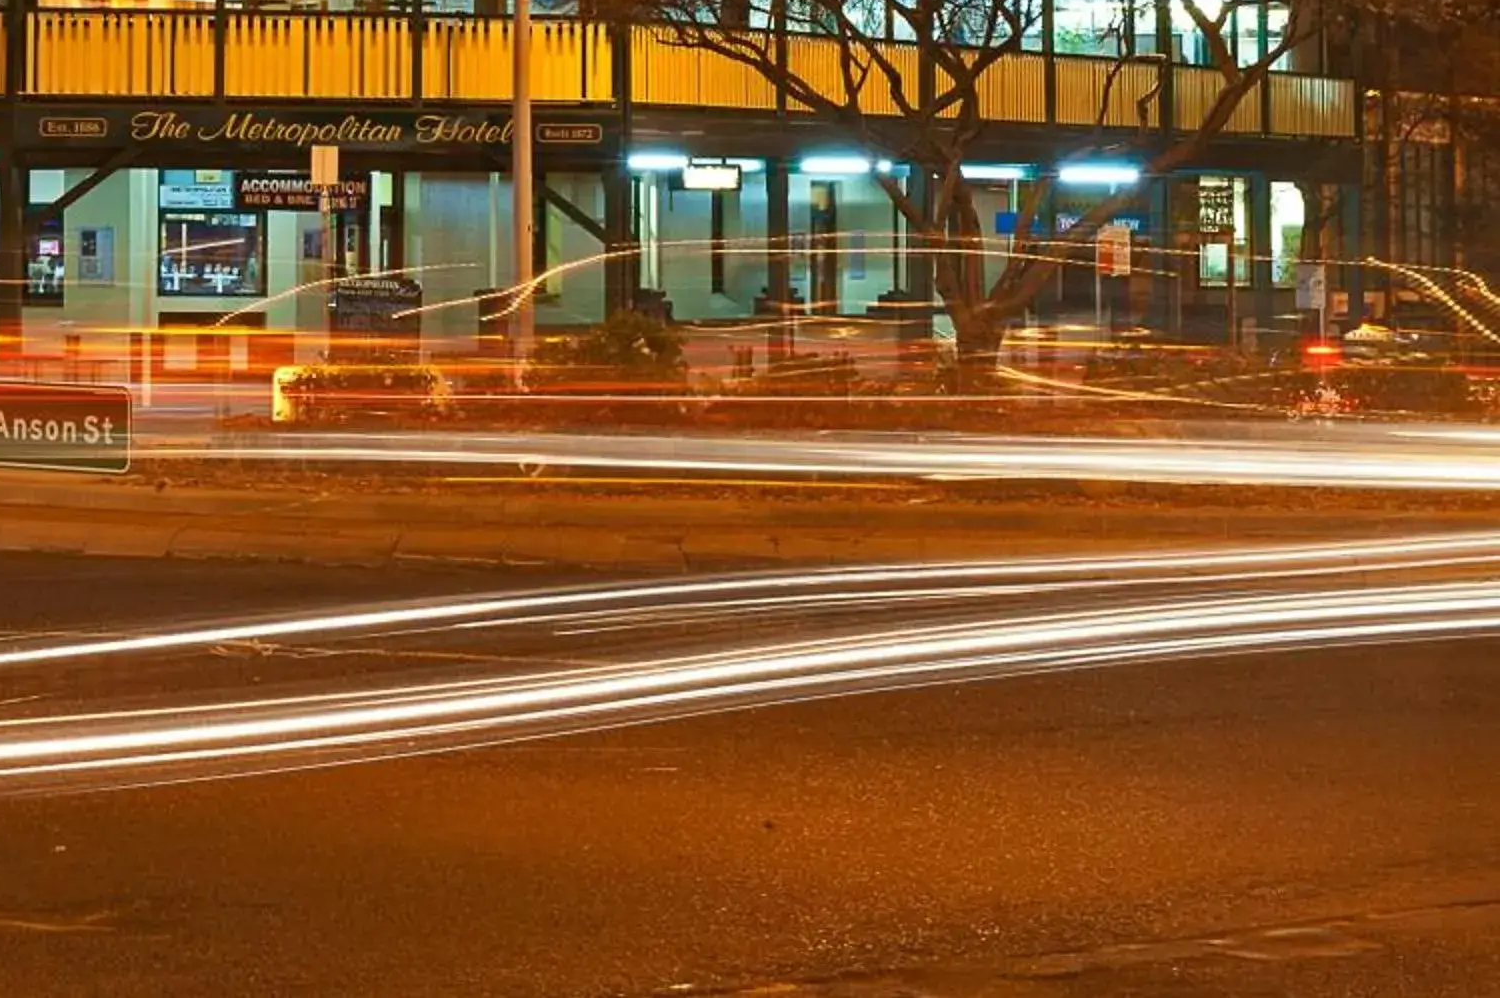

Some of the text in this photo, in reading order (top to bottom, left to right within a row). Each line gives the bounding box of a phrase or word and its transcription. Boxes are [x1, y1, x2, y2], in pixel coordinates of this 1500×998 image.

[131, 111, 514, 146] The Metropolitan Hotel
[83, 415, 114, 444] St
